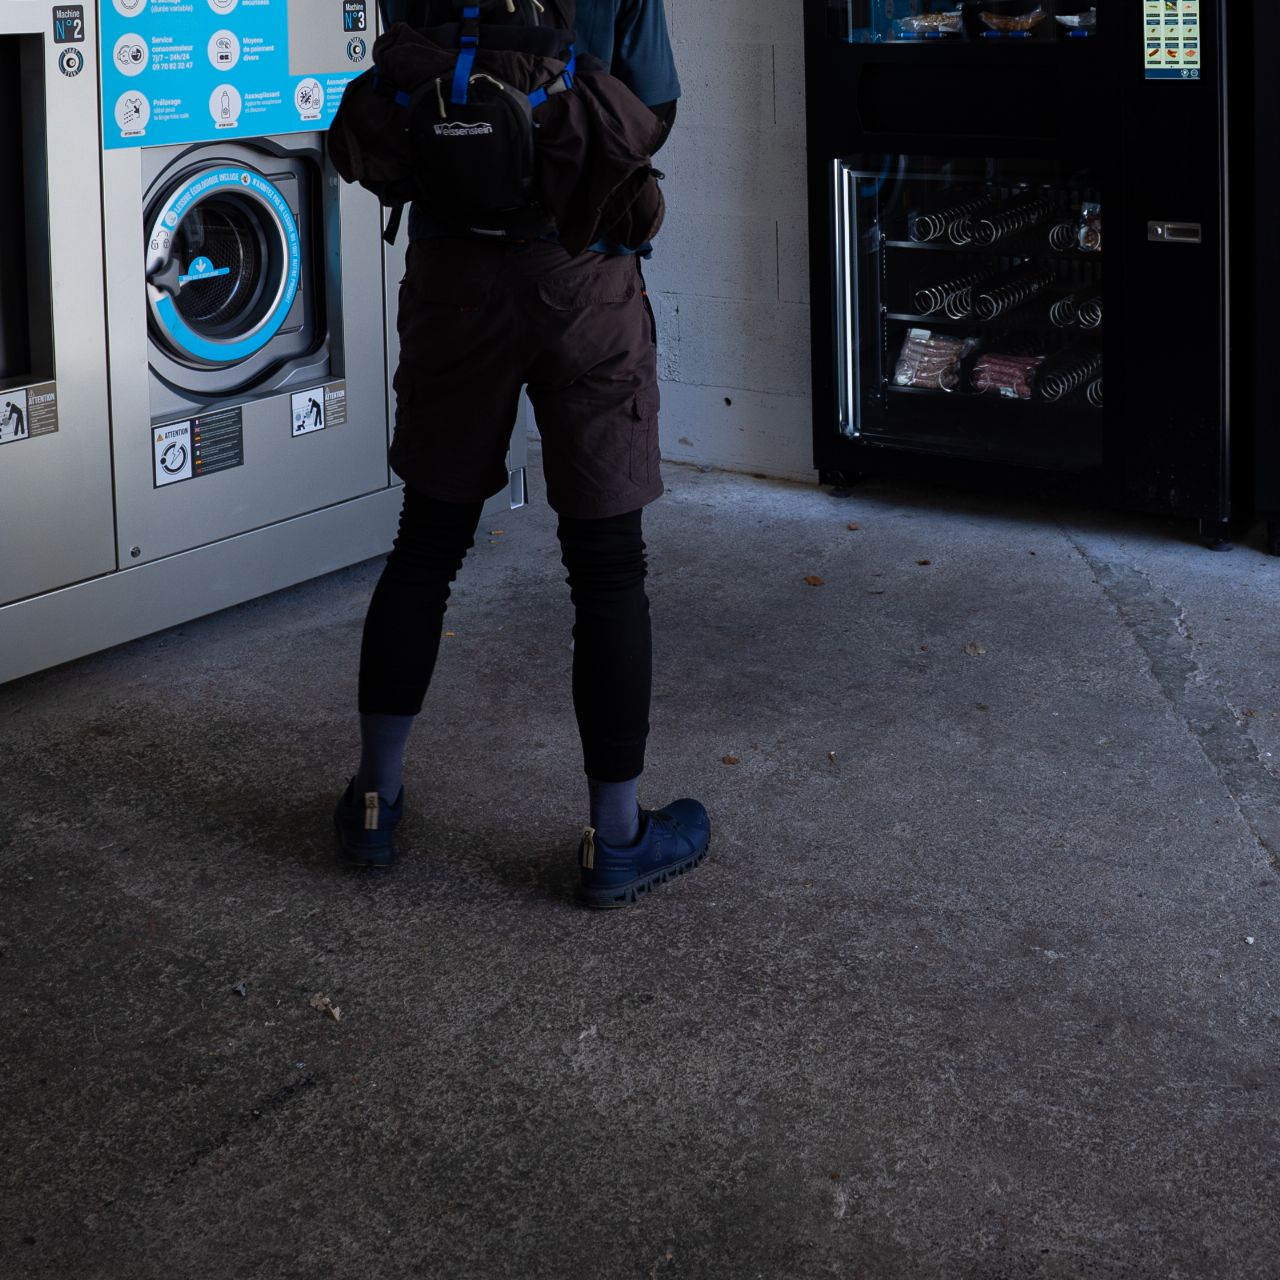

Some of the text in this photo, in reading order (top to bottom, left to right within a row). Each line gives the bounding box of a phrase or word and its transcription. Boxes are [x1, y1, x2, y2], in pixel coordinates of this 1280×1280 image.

[56, 10, 80, 19] Machine
[152, 36, 173, 44] Service
[434, 124, 493, 136] Weissenstein
[29, 392, 55, 406] ATTENTION
[165, 428, 188, 439] ATTENTION
